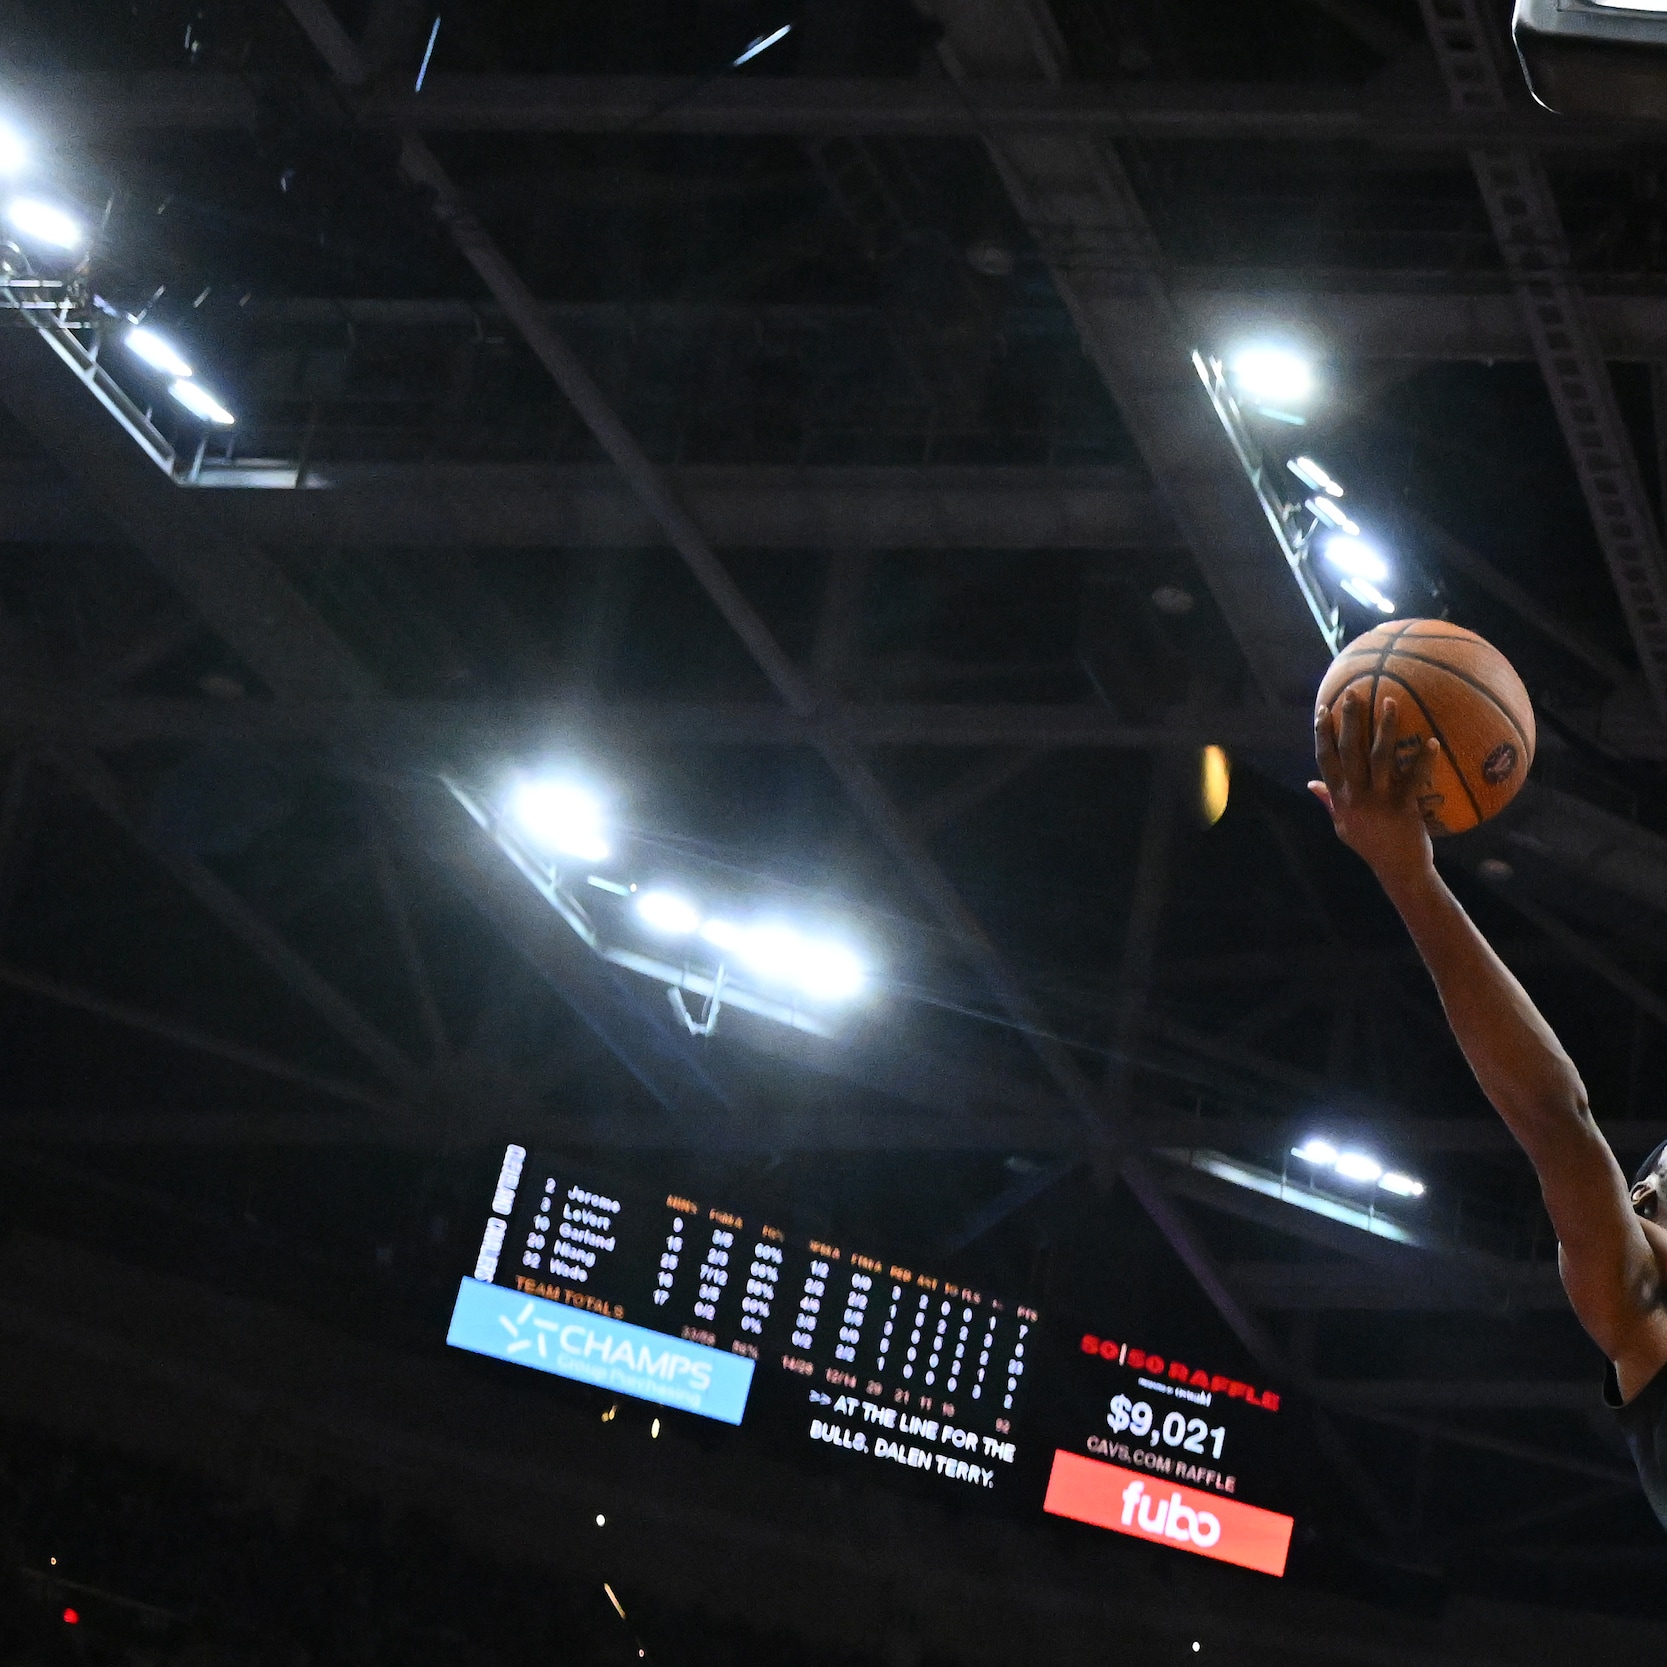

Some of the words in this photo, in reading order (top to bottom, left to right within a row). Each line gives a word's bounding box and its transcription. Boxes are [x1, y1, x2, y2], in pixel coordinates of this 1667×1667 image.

[568, 1186, 621, 1214] Jerome
[515, 1275, 560, 1300] TEAM
[560, 1323, 712, 1391] CHAMPS
[1168, 1359, 1281, 1412] RAFFLE
[833, 1394, 861, 1418] AT
[861, 1401, 898, 1429] THE
[899, 1412, 938, 1442] LINE
[940, 1425, 981, 1453] FOR
[982, 1434, 1016, 1463] THE
[874, 1437, 932, 1471] DALEN
[1107, 1393, 1226, 1460] $9,021
[1121, 1479, 1221, 1548] fubo
